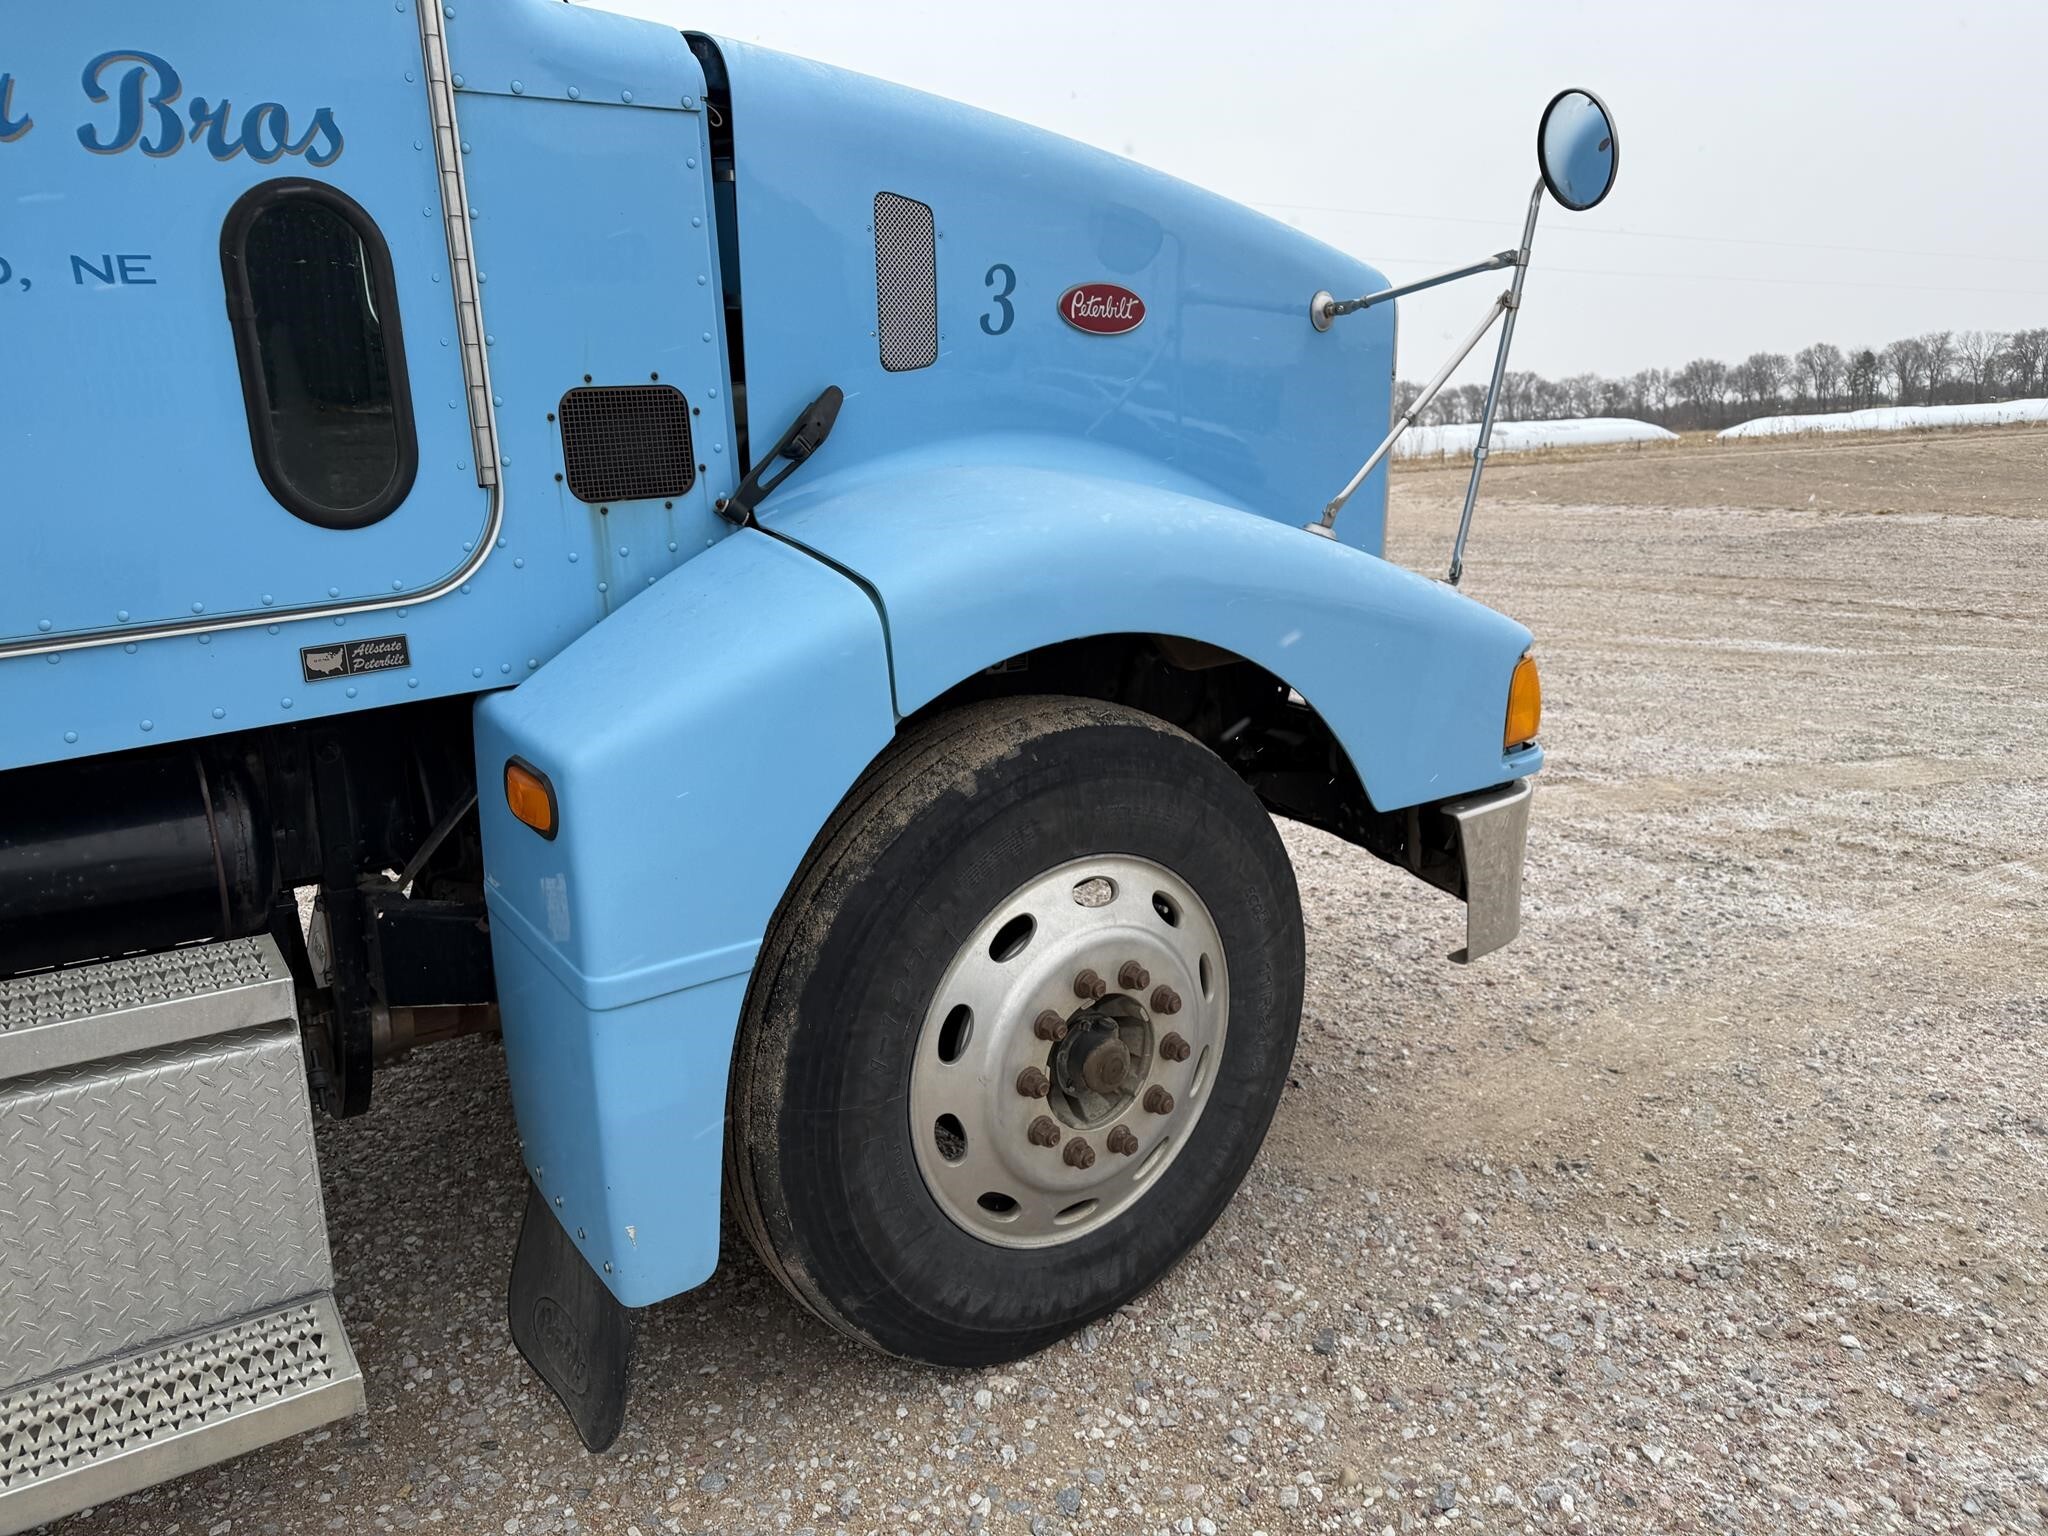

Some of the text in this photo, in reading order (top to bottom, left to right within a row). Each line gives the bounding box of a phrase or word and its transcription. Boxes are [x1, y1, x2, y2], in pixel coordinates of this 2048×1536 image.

[76, 49, 344, 167] Bros
[70, 254, 157, 285] NE
[980, 263, 1016, 336] 3
[1071, 290, 1139, 319] Peterbilt
[352, 641, 402, 657] Allstate
[352, 654, 405, 672] Peterbilt
